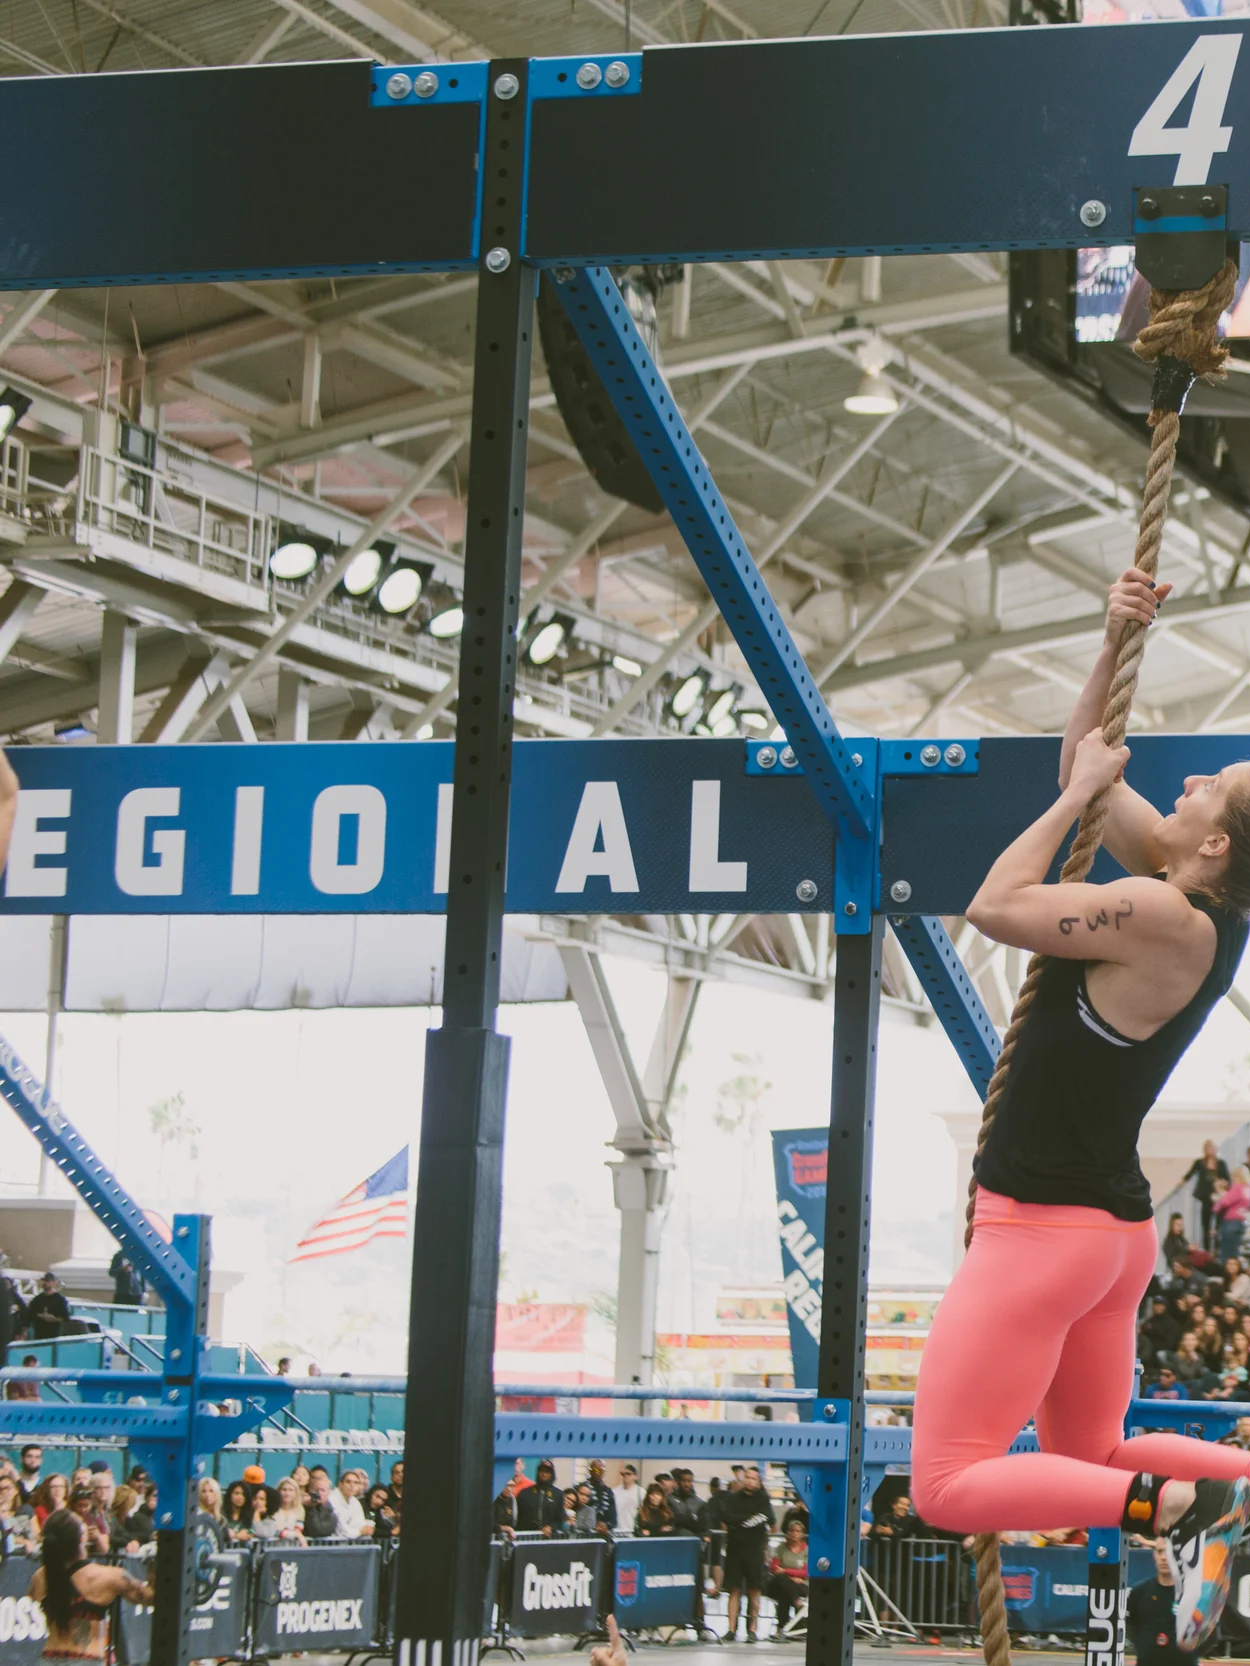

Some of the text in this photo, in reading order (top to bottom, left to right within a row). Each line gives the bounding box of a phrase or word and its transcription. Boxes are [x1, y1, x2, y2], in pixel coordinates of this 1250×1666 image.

[1128, 33, 1243, 187] 4
[4, 780, 748, 898] EGIOAL
[276, 1599, 363, 1635] PROGENEX
[523, 1561, 594, 1611] CrossFit
